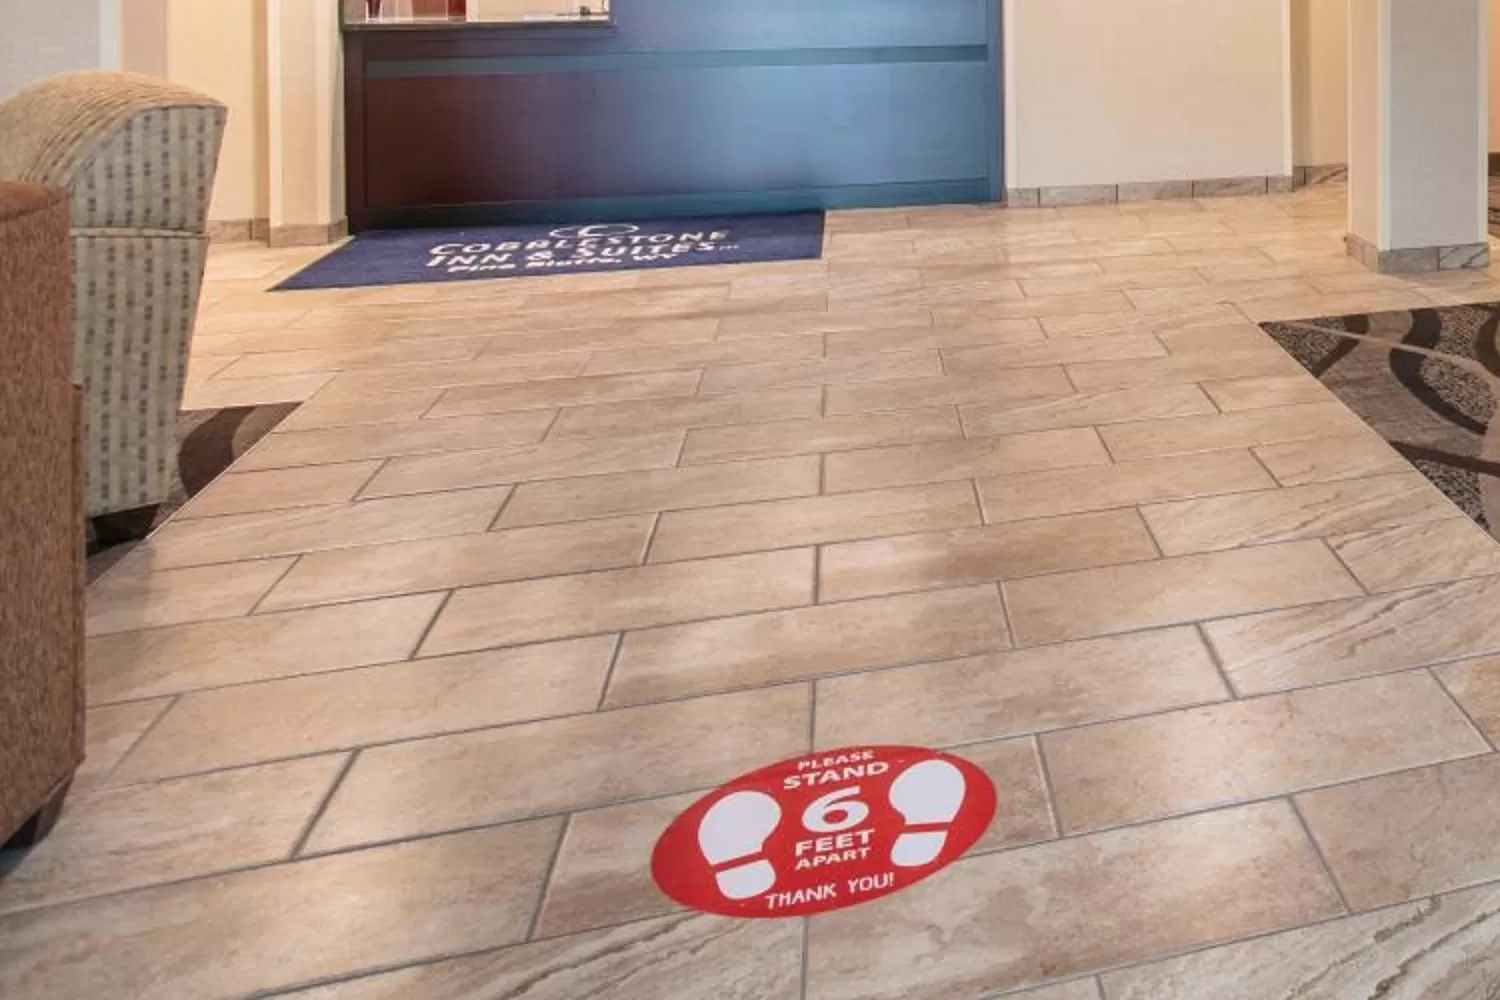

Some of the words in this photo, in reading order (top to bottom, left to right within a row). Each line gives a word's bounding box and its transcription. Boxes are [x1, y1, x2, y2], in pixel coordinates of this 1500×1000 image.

[425, 252, 513, 267] INN
[797, 749, 876, 771] PLEASE
[783, 761, 890, 790] STAND
[801, 785, 869, 833] 6
[795, 828, 876, 857] FEET
[795, 847, 871, 871] APART
[764, 883, 838, 910] THANK
[847, 872, 895, 895] YOU!
